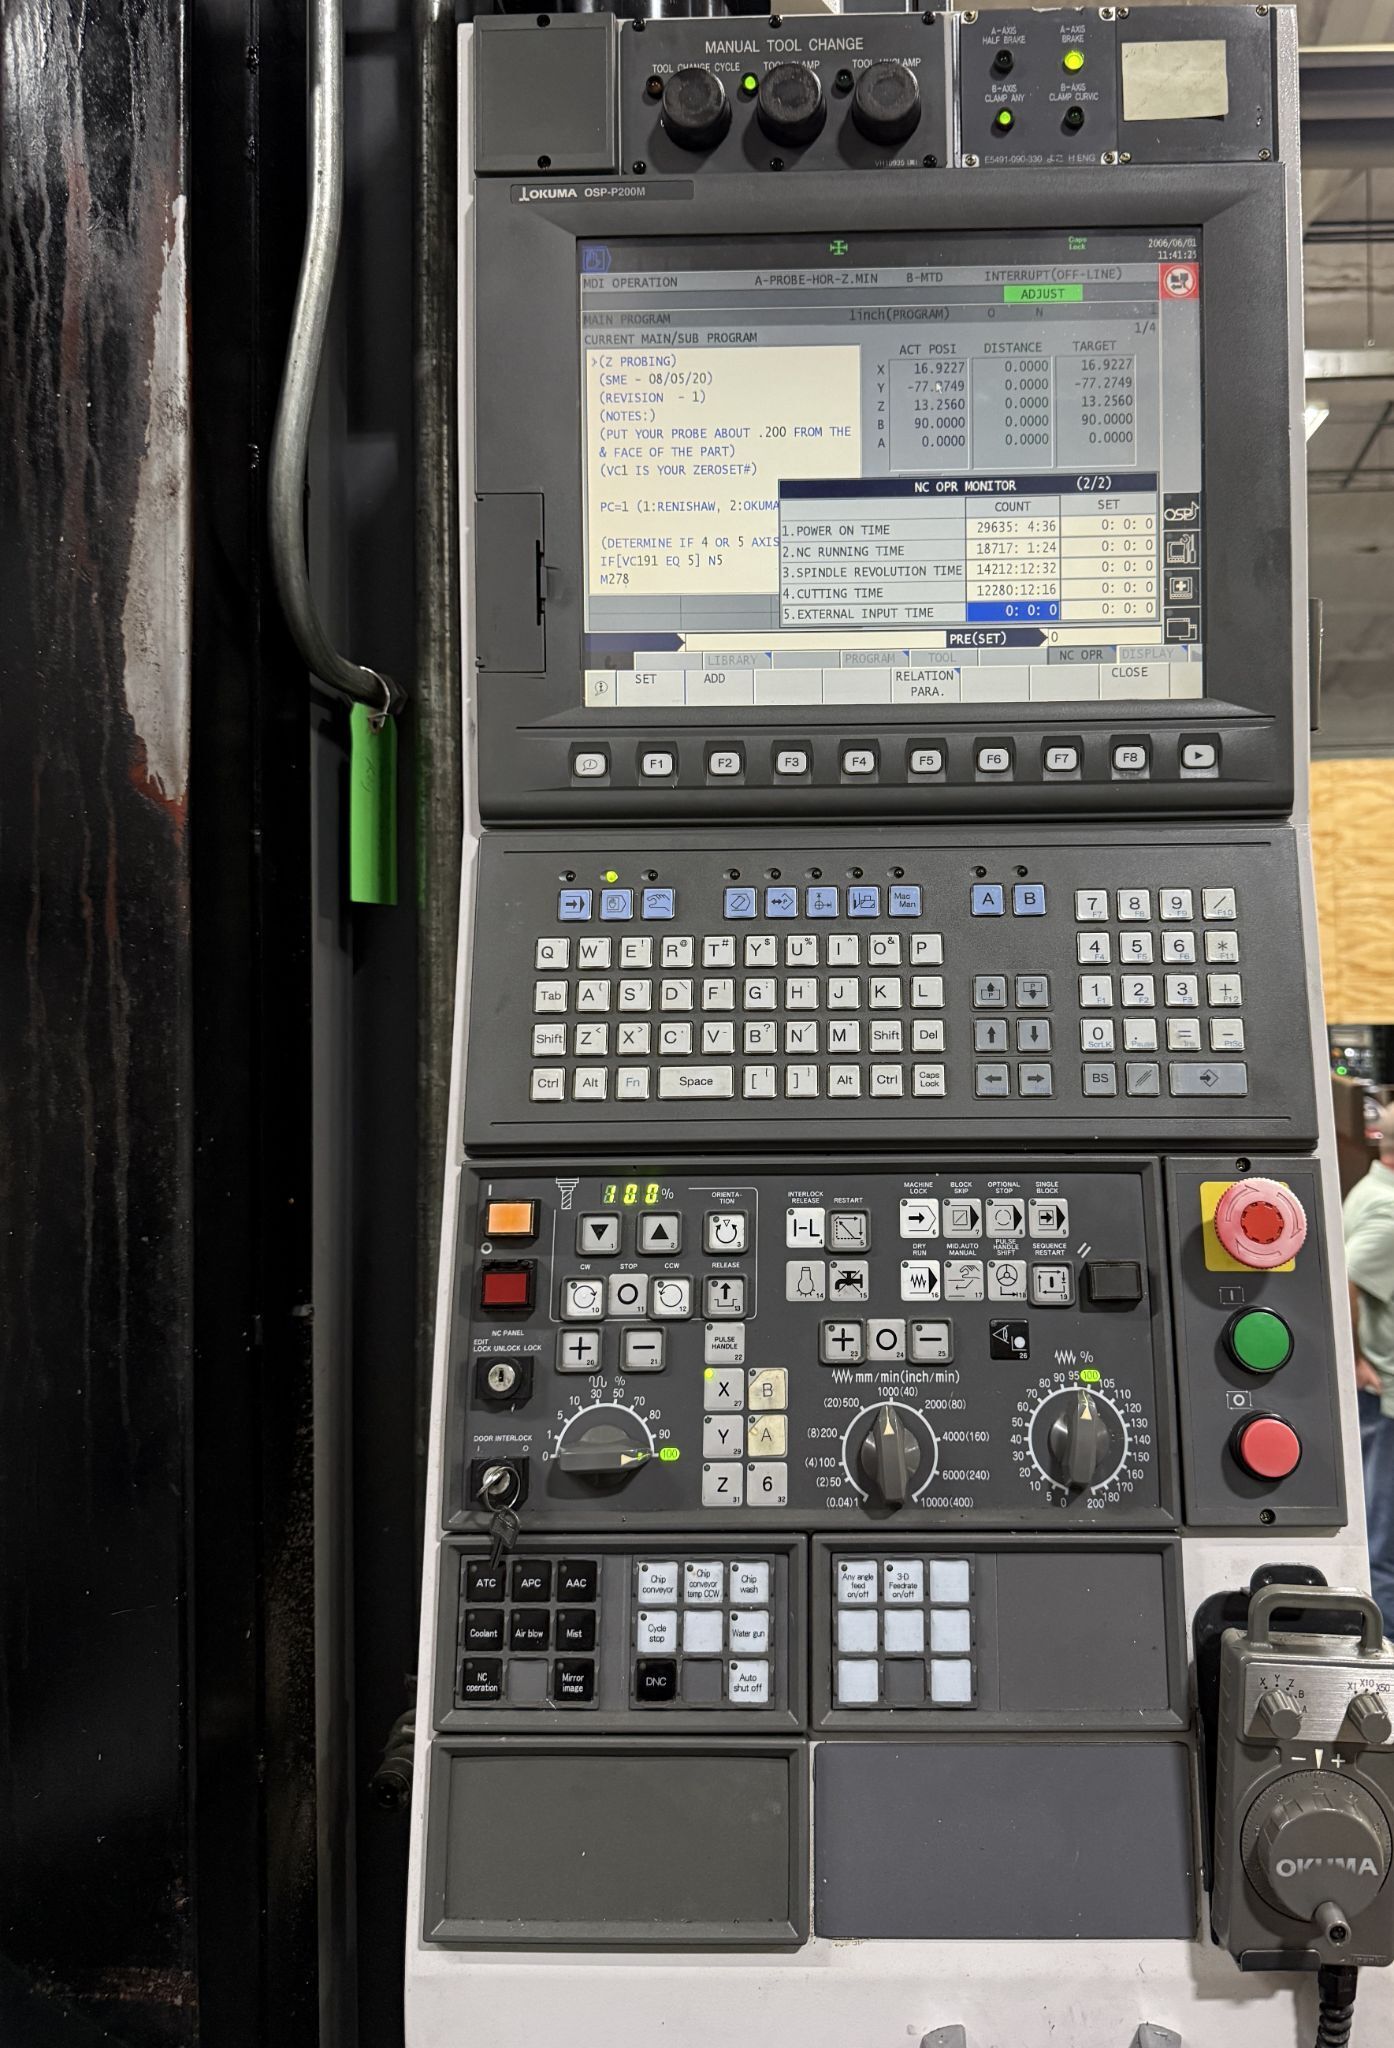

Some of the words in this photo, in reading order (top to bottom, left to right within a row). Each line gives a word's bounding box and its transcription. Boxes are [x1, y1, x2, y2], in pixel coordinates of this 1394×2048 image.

[1060, 25, 1085, 33] A-AXIS
[1062, 34, 1084, 43] BRAKE
[705, 38, 760, 54] MANUAL
[767, 39, 801, 52] TOOL
[809, 37, 863, 52] CHANGE
[652, 64, 673, 74] TOOL
[715, 63, 740, 72] CYCLE
[992, 84, 1017, 93] B-AXIS
[985, 94, 1007, 102] CLAMP
[1011, 93, 1024, 102] ANY
[519, 187, 577, 201] OKUMA
[584, 186, 646, 197] OSP-P200M
[583, 278, 604, 289] MDI
[612, 277, 678, 288] OPERATION
[754, 273, 878, 286] A-PROBE-HOR-Z.MIN
[906, 272, 943, 283] B-MTD
[984, 268, 1122, 282] INTERRUPT(OFF-LINE)
[1021, 288, 1065, 300] ADJUST
[583, 314, 616, 325] MAIN
[620, 314, 670, 324] PROGRAM
[850, 307, 950, 321] 1inch(PROGRAM)
[584, 334, 634, 345] CURRENT
[642, 333, 699, 344] MAIN/SUB
[707, 332, 757, 343] PROGRAM
[899, 344, 921, 356] ACT
[930, 343, 956, 355] POSI
[984, 341, 1042, 354] DISTANCE
[1072, 340, 1116, 352] TARGET
[914, 362, 964, 374] 16.9227
[1081, 358, 1132, 371] 16.9227
[914, 398, 965, 411] 13.2560
[600, 410, 656, 422] (NOTES:)
[1081, 413, 1133, 425] 90.0000
[600, 428, 628, 440] (PUT
[636, 428, 664, 440] YOUR
[671, 428, 707, 439] PROBE
[714, 427, 750, 438] ABOUT
[758, 426, 786, 438] .200
[794, 426, 823, 437] FROM
[830, 426, 851, 437] THE
[599, 447, 607, 458] &
[614, 447, 643, 458] FACE
[649, 447, 664, 458] OF
[671, 446, 692, 457] THE
[700, 445, 735, 457] PART)
[636, 465, 649, 476] IS
[658, 464, 686, 475] YOUR
[693, 463, 757, 476] ZEROSET#)
[914, 481, 930, 493] NC
[936, 481, 959, 493] OPR
[965, 480, 1016, 492] MONITOR
[1076, 475, 1112, 491] (2/2)
[600, 502, 629, 513] PC=1
[637, 501, 721, 514] (1:RENISHAW,
[730, 500, 779, 512] 2:OKUMA
[995, 501, 1031, 512] COUNT
[1098, 499, 1120, 511] SET
[782, 524, 833, 537] 1.POWER
[840, 524, 854, 536] ON
[861, 524, 890, 535] TIME
[977, 521, 1019, 533] 29635:
[1027, 520, 1056, 532] 4:36
[782, 545, 812, 558] 2.NC
[818, 545, 869, 557] RUNNING
[876, 545, 904, 556] TIME
[977, 542, 1018, 555] 18717:
[1027, 541, 1056, 554] 1:24
[782, 565, 847, 579] 3.SPINDLE
[855, 565, 926, 577] REVOLUTION
[933, 564, 962, 576] TIME
[977, 562, 1056, 576] 14212:12:32
[783, 587, 847, 600] 4.CUTTING
[855, 587, 883, 599] TIME
[977, 583, 1056, 597] 12280:12:16
[784, 607, 855, 621] 5.EXTERNAL
[861, 607, 898, 619] INPUT
[905, 606, 934, 618] TIME
[950, 632, 1007, 646] PRE(SET)
[845, 653, 895, 664] PROGRAM
[1122, 647, 1175, 660] DISPLAY
[896, 670, 954, 682] RELATION
[1111, 666, 1148, 678] CLOSE
[635, 674, 656, 684] SET
[704, 673, 726, 683] ADD
[911, 686, 945, 698] PARA.
[785, 757, 799, 767] F3
[919, 756, 933, 765] F5
[1123, 752, 1138, 762] F8
[650, 759, 663, 768] F1
[894, 892, 911, 900] Mac
[899, 900, 916, 908] Man
[541, 990, 561, 1001] Tab
[536, 1033, 562, 1044] Shift
[919, 1029, 938, 1040] Del
[919, 1071, 940, 1081] Caps
[537, 1077, 559, 1088] Ctrl
[679, 1076, 713, 1088] Space
[920, 1079, 939, 1088] Lock
[855, 1370, 960, 1384] mm/min(inch/min)
[877, 1385, 918, 1397] 1000(40)
[824, 1397, 859, 1408] (20)500
[925, 1399, 966, 1410] 2000(80)
[659, 1429, 670, 1439] 90
[942, 1431, 990, 1442] 4000(160)
[805, 1457, 836, 1468] (4)100
[921, 1496, 974, 1508] 10000(400)
[476, 1578, 496, 1588] ATC
[651, 1575, 666, 1583] Chip
[741, 1575, 757, 1583] Chip
[842, 1573, 855, 1582] Any
[857, 1573, 874, 1582] angle
[566, 1579, 587, 1588] AAC
[740, 1585, 758, 1593] wash
[888, 1581, 918, 1590] Feedrate
[470, 1628, 498, 1638] Coolant
[515, 1629, 526, 1637] Air
[528, 1629, 544, 1638] blow
[732, 1629, 750, 1637] Water
[753, 1630, 765, 1638] gun
[562, 1672, 584, 1682] Mirror
[646, 1677, 667, 1687] DNC
[562, 1683, 584, 1693] image
[1360, 1679, 1374, 1687] X10
